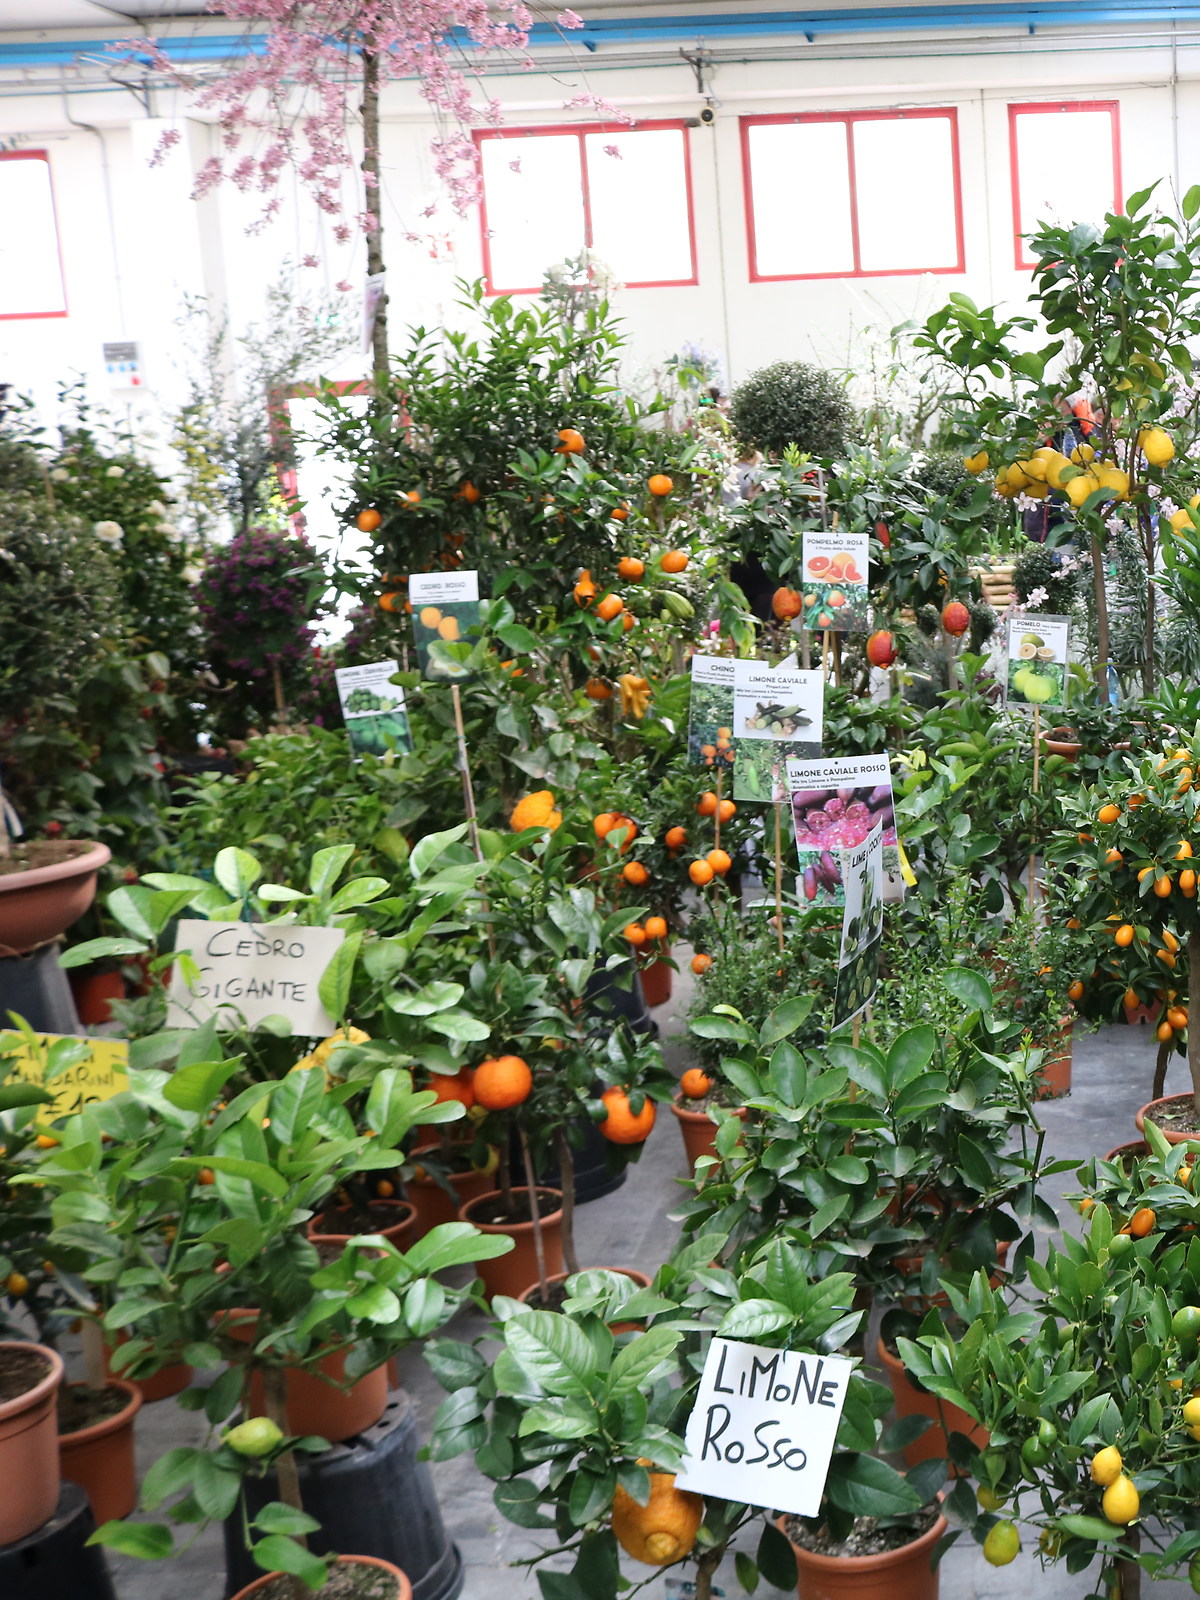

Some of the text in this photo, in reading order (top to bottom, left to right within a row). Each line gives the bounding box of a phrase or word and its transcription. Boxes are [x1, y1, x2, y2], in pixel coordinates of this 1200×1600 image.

[790, 764, 886, 778] LIMONE CAVIALE ROSSO
[852, 849, 866, 868] LIME
[206, 927, 305, 959] CEDRO
[713, 1344, 839, 1408] LIMONE
[701, 1403, 807, 1471] ROSSO
